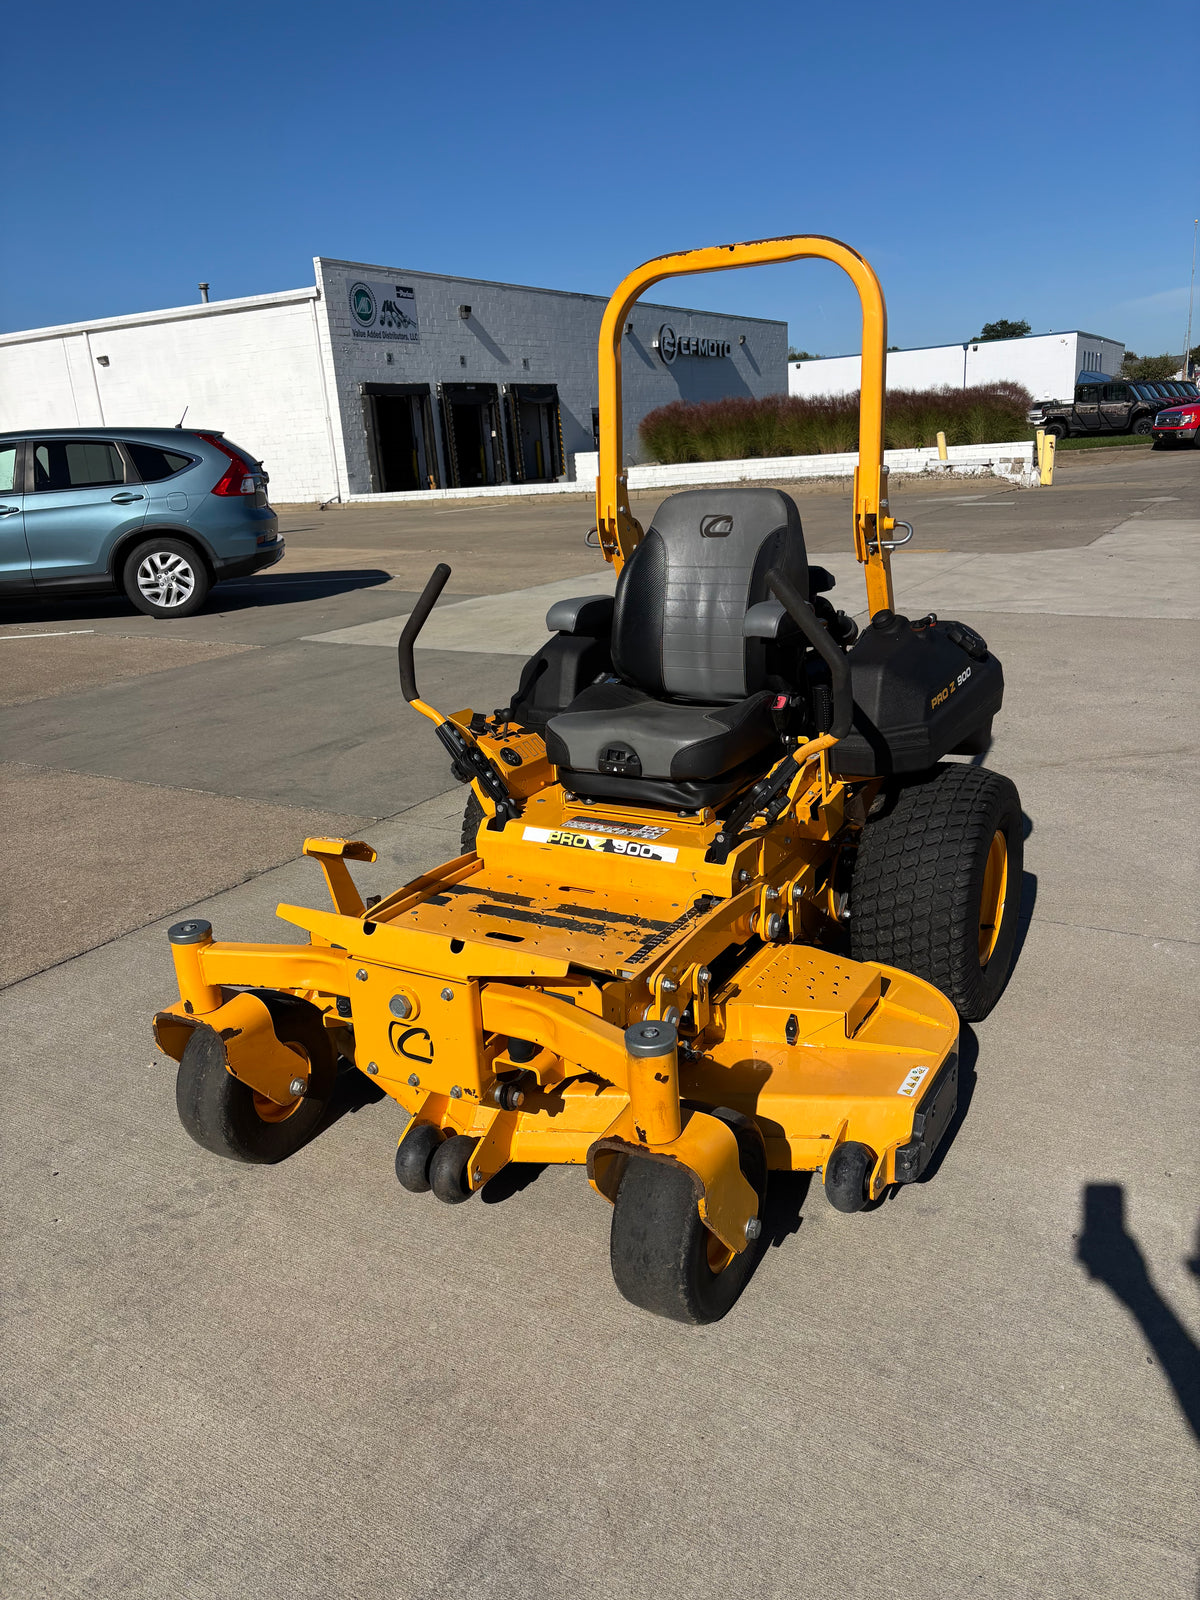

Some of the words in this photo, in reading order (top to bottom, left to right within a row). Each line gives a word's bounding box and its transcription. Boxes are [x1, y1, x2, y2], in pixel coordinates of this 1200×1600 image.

[352, 329, 366, 338] Value
[367, 330, 381, 339] Added
[410, 332, 419, 341] LLC
[678, 336, 732, 358] CFMOTO
[931, 687, 949, 710] PRO
[949, 681, 956, 694] Z
[956, 666, 972, 686] 900
[547, 831, 588, 848] PRO
[593, 838, 607, 851] Z
[613, 842, 653, 857] 900
